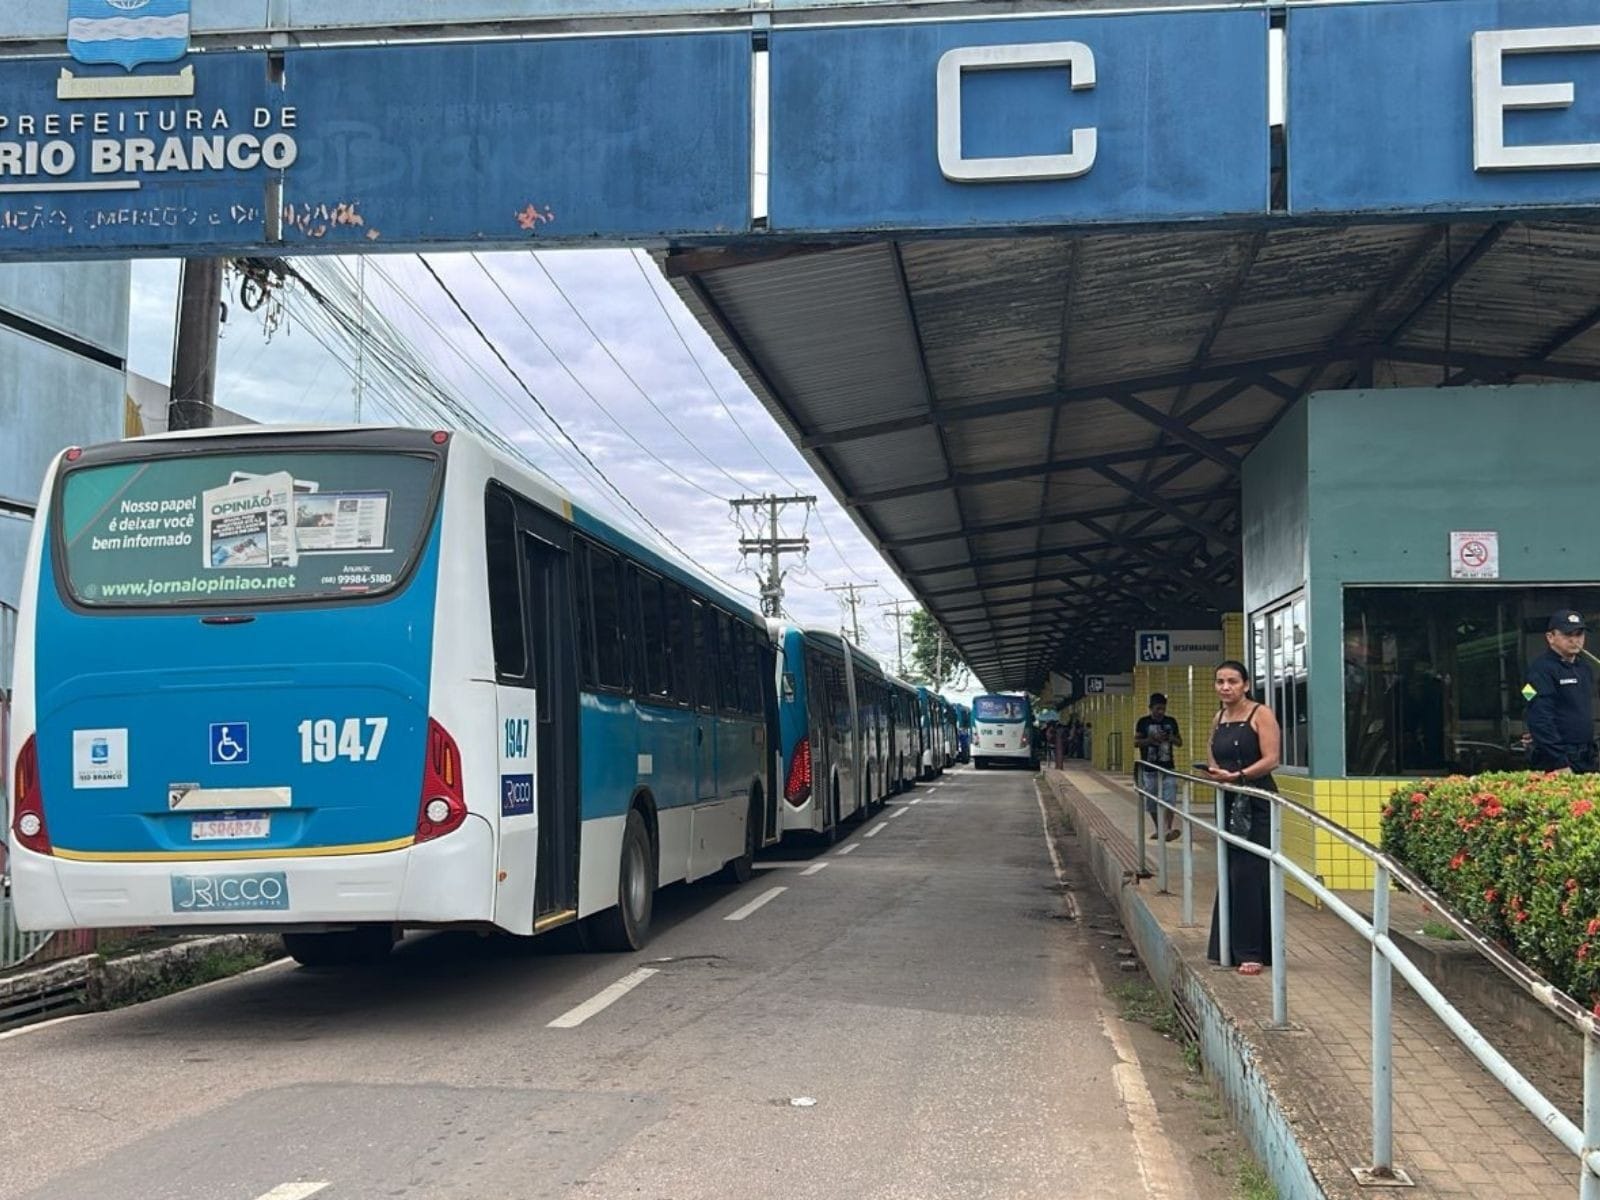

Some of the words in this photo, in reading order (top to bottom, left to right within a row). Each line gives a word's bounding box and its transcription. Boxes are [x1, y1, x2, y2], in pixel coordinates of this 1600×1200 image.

[254, 107, 297, 128] DE
[0, 139, 75, 175] RIO
[92, 133, 298, 174] BRANCO
[121, 500, 159, 513] Nosso
[160, 496, 197, 513] papel
[212, 495, 272, 515] OPINIÃO
[109, 517, 117, 532] é
[119, 518, 160, 531] deixar
[163, 513, 195, 529] você
[92, 536, 121, 550] bem
[123, 532, 192, 549] informado
[102, 574, 296, 597] www.jornalopiniao.net
[297, 717, 388, 764] 1947
[504, 718, 529, 759] 1947
